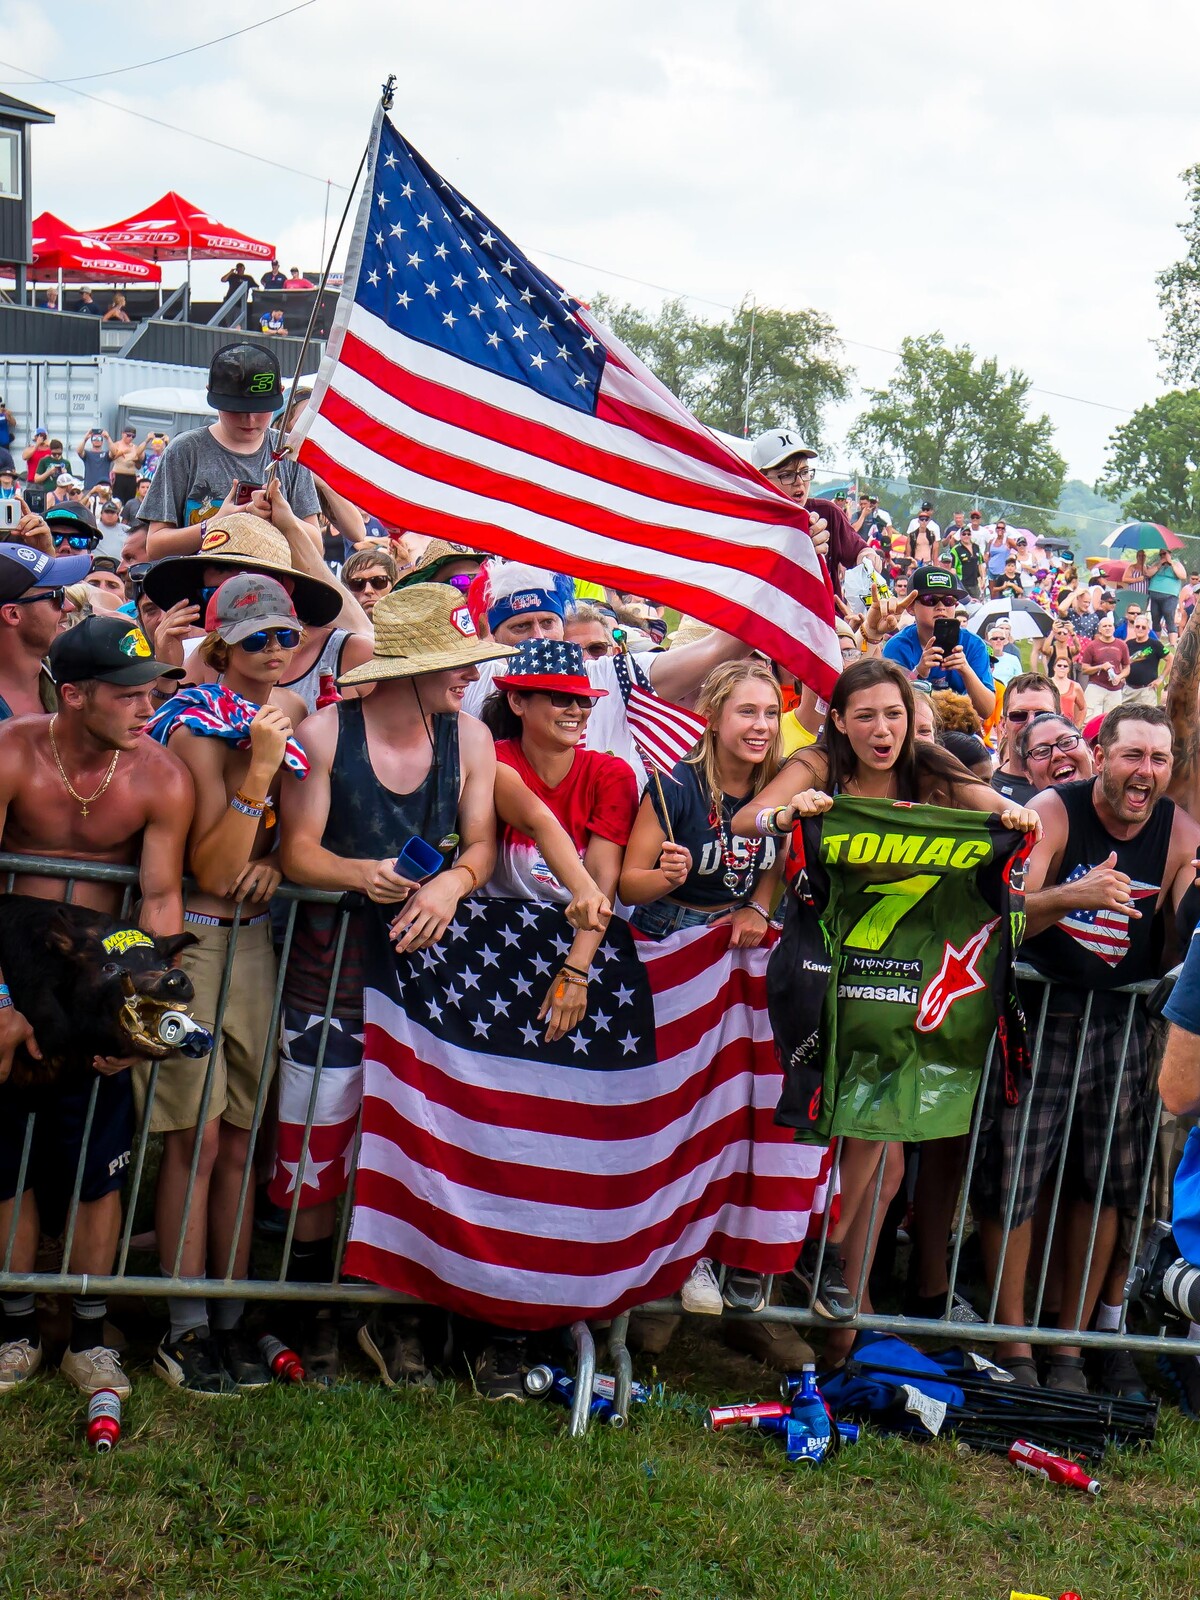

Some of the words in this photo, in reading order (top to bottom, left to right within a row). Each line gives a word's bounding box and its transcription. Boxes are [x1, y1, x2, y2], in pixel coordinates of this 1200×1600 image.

[250, 372, 275, 393] 3
[697, 835, 776, 876] USA
[823, 832, 991, 869] TOMAC
[841, 872, 945, 953] 7
[853, 958, 920, 972] MONSTER
[861, 970, 909, 978] ENERGY
